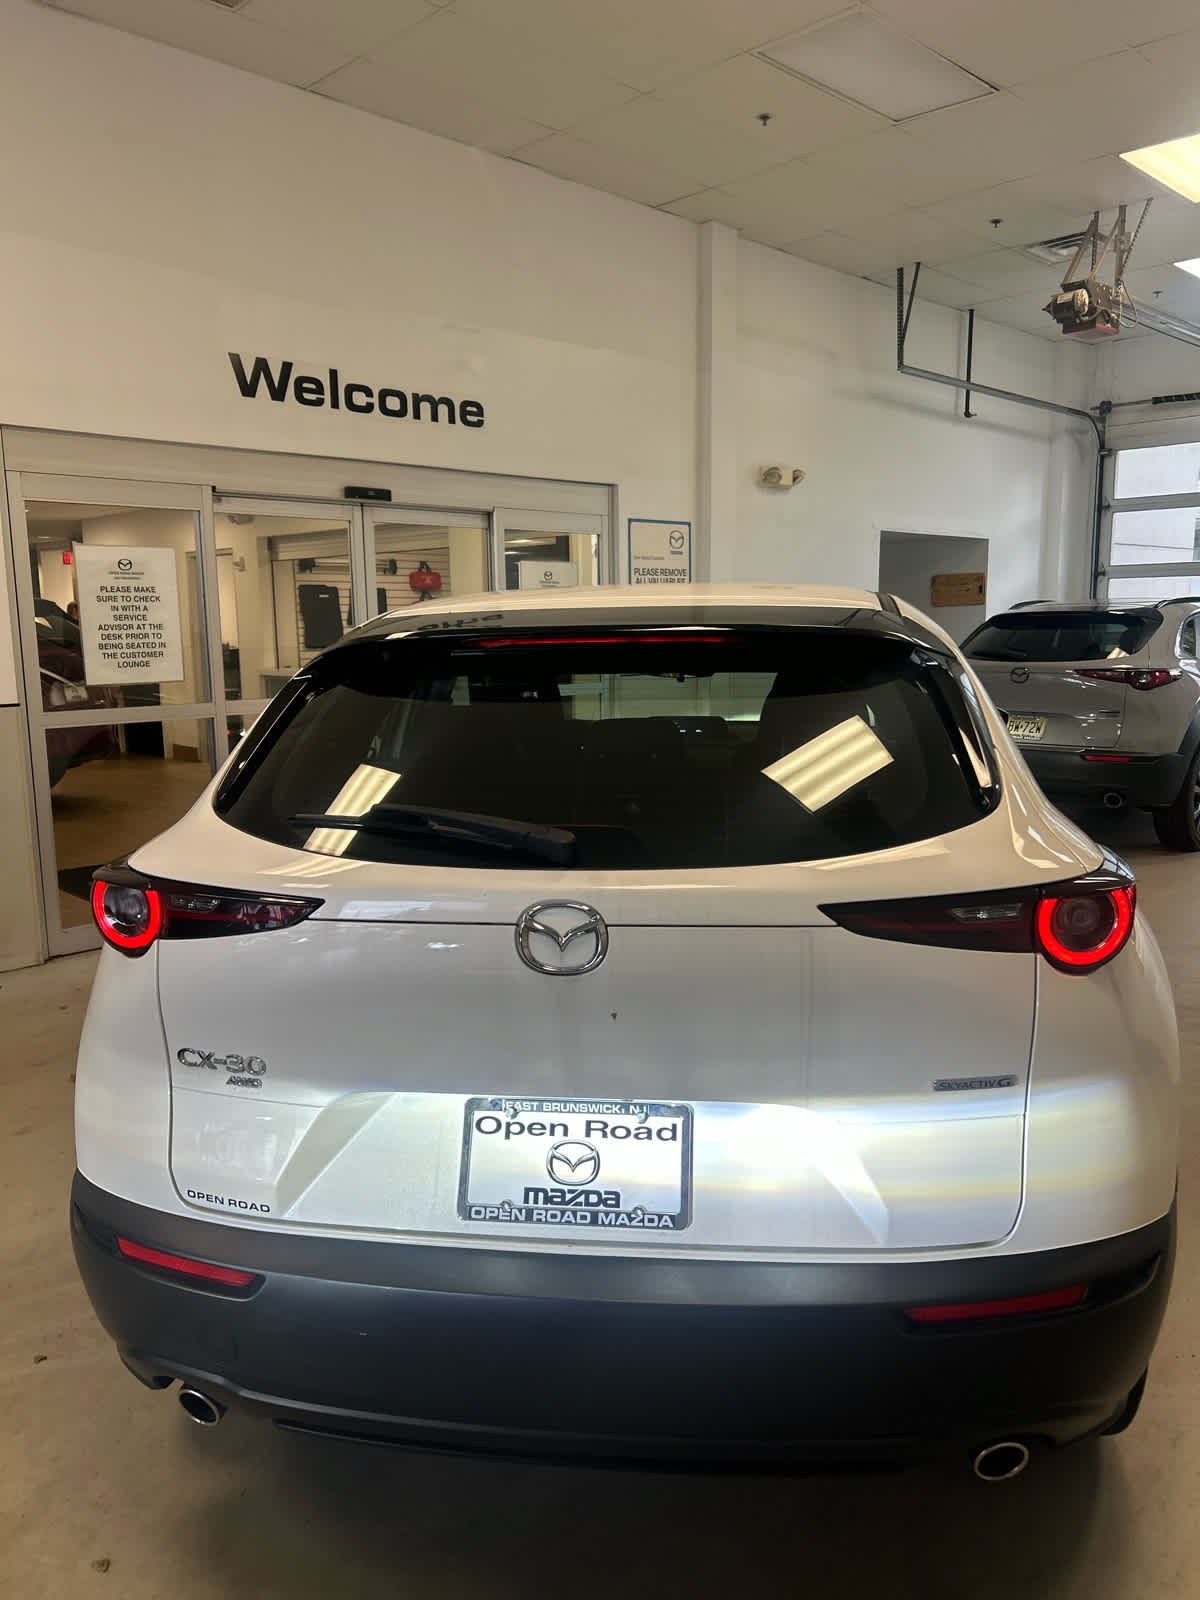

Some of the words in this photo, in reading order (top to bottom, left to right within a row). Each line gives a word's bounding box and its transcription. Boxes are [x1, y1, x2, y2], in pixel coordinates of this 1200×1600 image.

[228, 352, 485, 428] Welcome
[633, 568, 659, 576] PLEASE
[660, 568, 687, 577] REMOVE
[100, 585, 131, 593] PLEASE
[149, 623, 164, 631] THE
[101, 633, 123, 641] DESK
[151, 632, 162, 640] TO
[98, 642, 123, 650] BEING
[125, 642, 156, 650] SEATED
[120, 650, 164, 659] CUSTOMER
[117, 660, 151, 668] LOUNGE
[177, 1048, 267, 1076] CX-30
[506, 1101, 538, 1112] EAST
[542, 1102, 625, 1115] BRUNSWICK,
[475, 1115, 569, 1140] Open
[585, 1119, 678, 1142] Road
[187, 1189, 225, 1205] OPEN
[228, 1198, 271, 1213] ROAD
[523, 1187, 621, 1209] mazda
[470, 1206, 526, 1222] OPEN
[533, 1209, 591, 1225] ROAD
[597, 1213, 674, 1229] MAZDA
